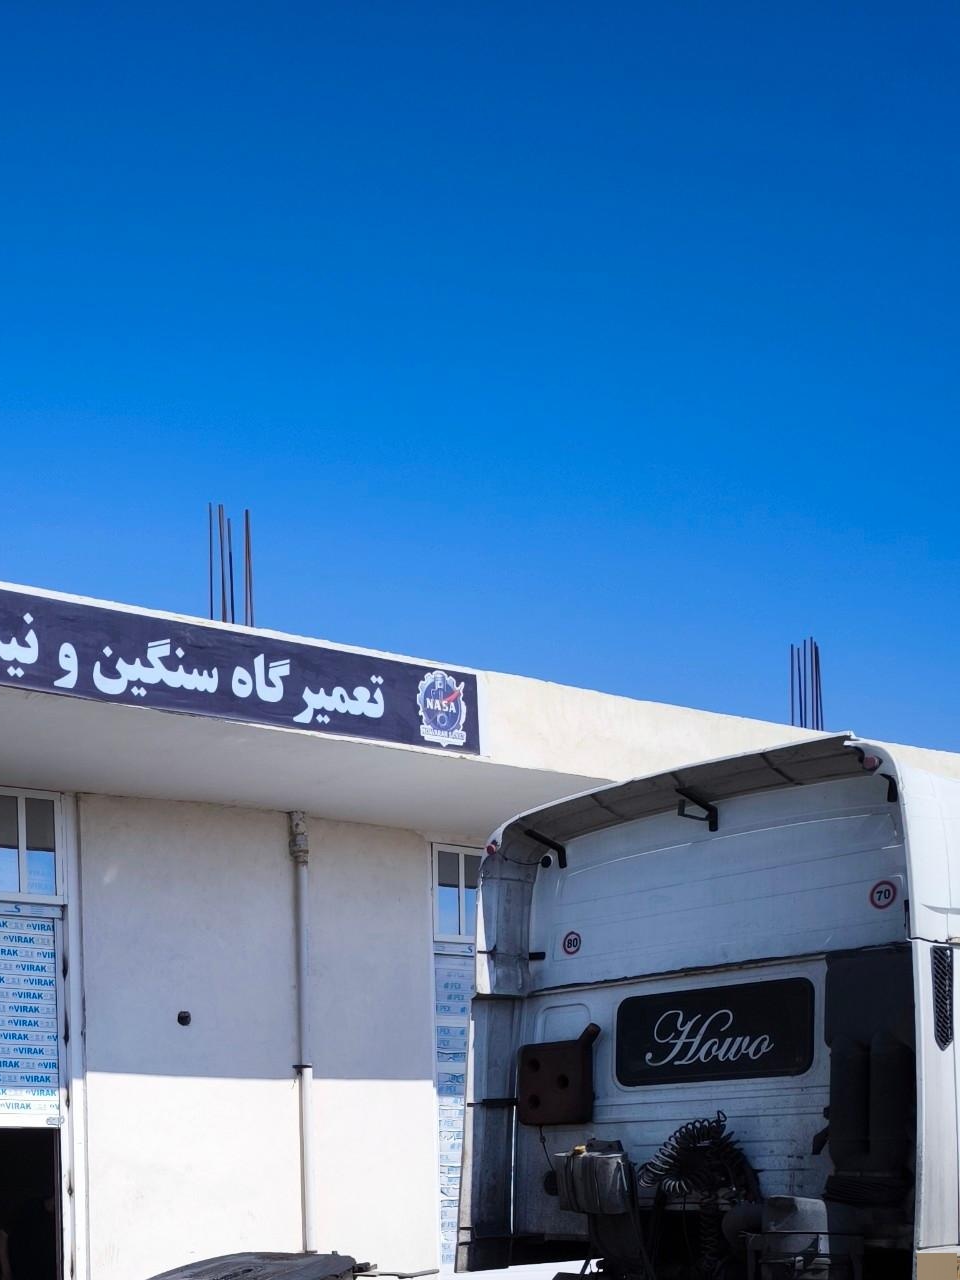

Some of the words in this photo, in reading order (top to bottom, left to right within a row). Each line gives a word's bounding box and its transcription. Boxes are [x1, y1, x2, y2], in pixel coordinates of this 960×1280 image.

[53, 642, 79, 688] و
[93, 638, 219, 697] سنگین
[426, 698, 456, 713] NASA
[876, 889, 891, 902] 70
[8, 935, 34, 944] VIRAK
[567, 938, 578, 949] 80
[20, 964, 46, 973] VIRAK
[28, 978, 54, 987] VIRAK
[17, 991, 43, 1000] VIRAK
[13, 1005, 39, 1014] VIRAK
[13, 1019, 39, 1028] VIRAK
[2, 1032, 29, 1041] VIRAK
[645, 1009, 776, 1067] Howo
[18, 1047, 44, 1055] VIRAK
[25, 1075, 50, 1083] VIRAK
[5, 1102, 31, 1110] VIRAK
